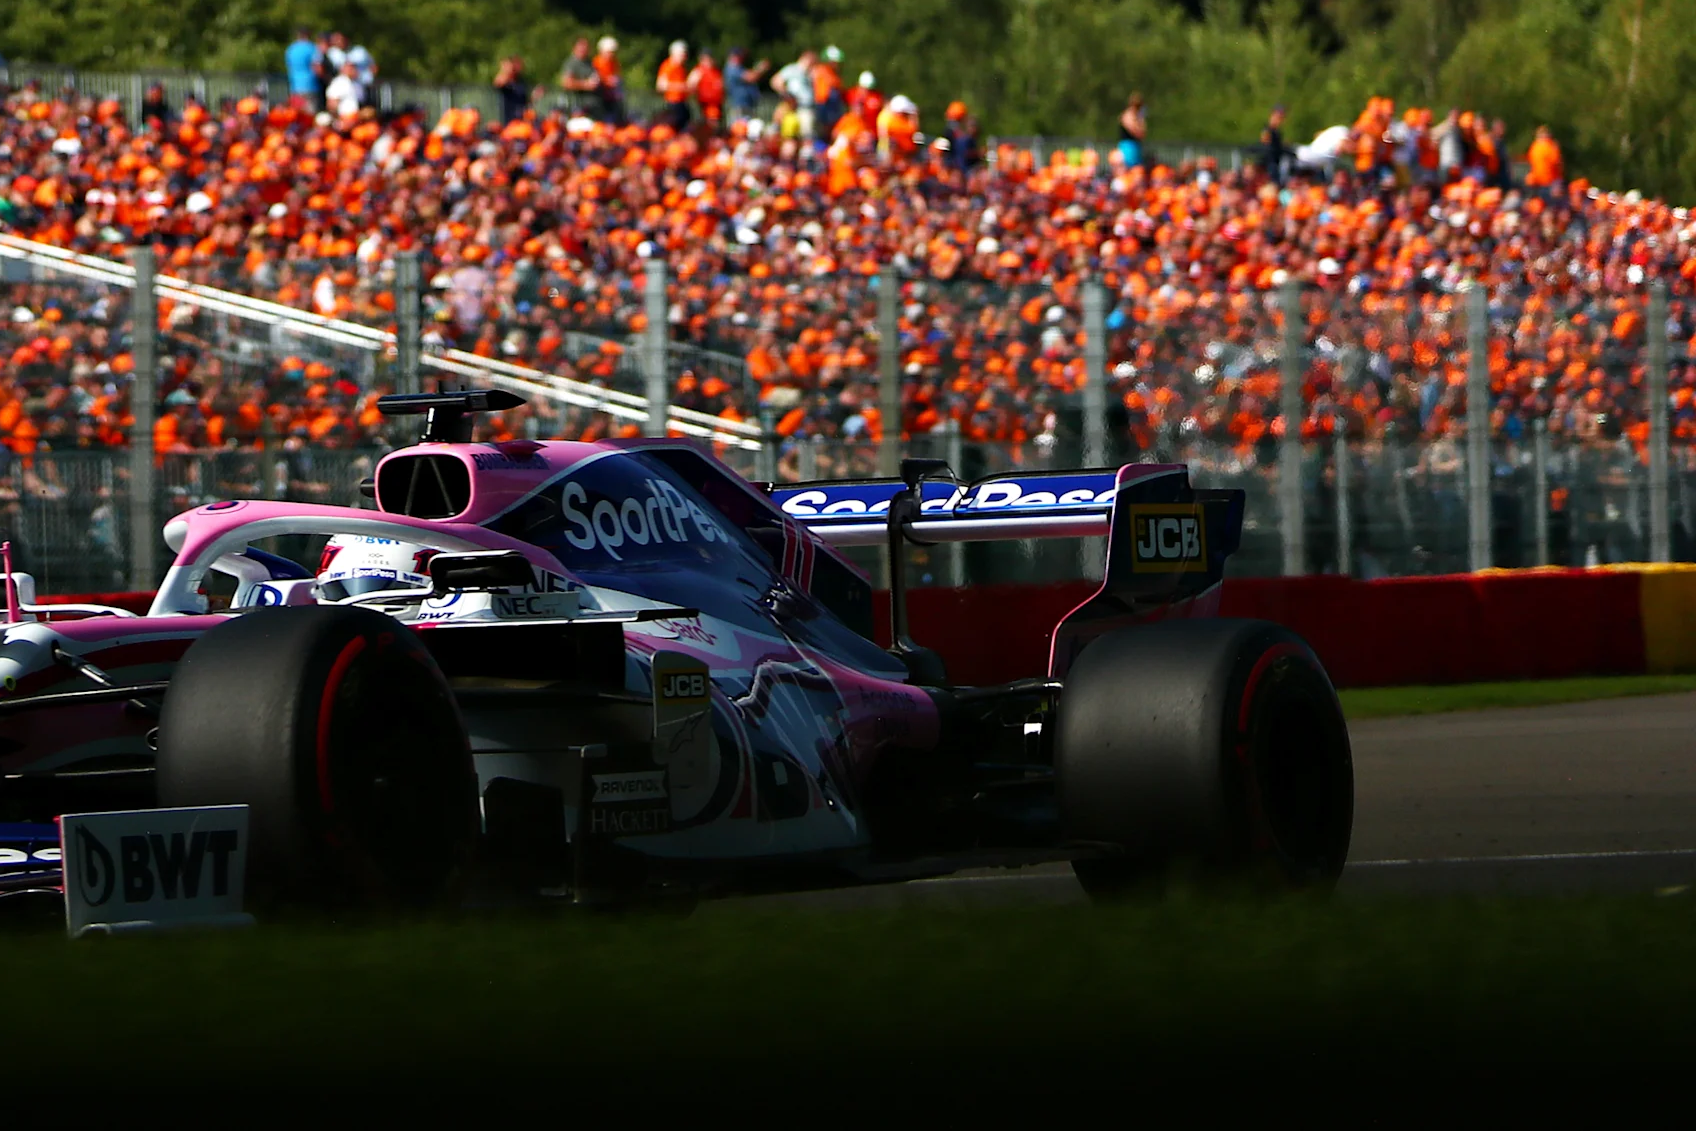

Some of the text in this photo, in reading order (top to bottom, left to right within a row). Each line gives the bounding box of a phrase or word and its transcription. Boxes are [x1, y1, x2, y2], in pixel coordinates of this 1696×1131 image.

[1137, 518, 1200, 558] JCB
[353, 568, 396, 579] SportPesa
[497, 597, 542, 616] NEC
[664, 675, 705, 697] JCB
[590, 808, 668, 834] HACKETT
[120, 830, 239, 904] BWT
